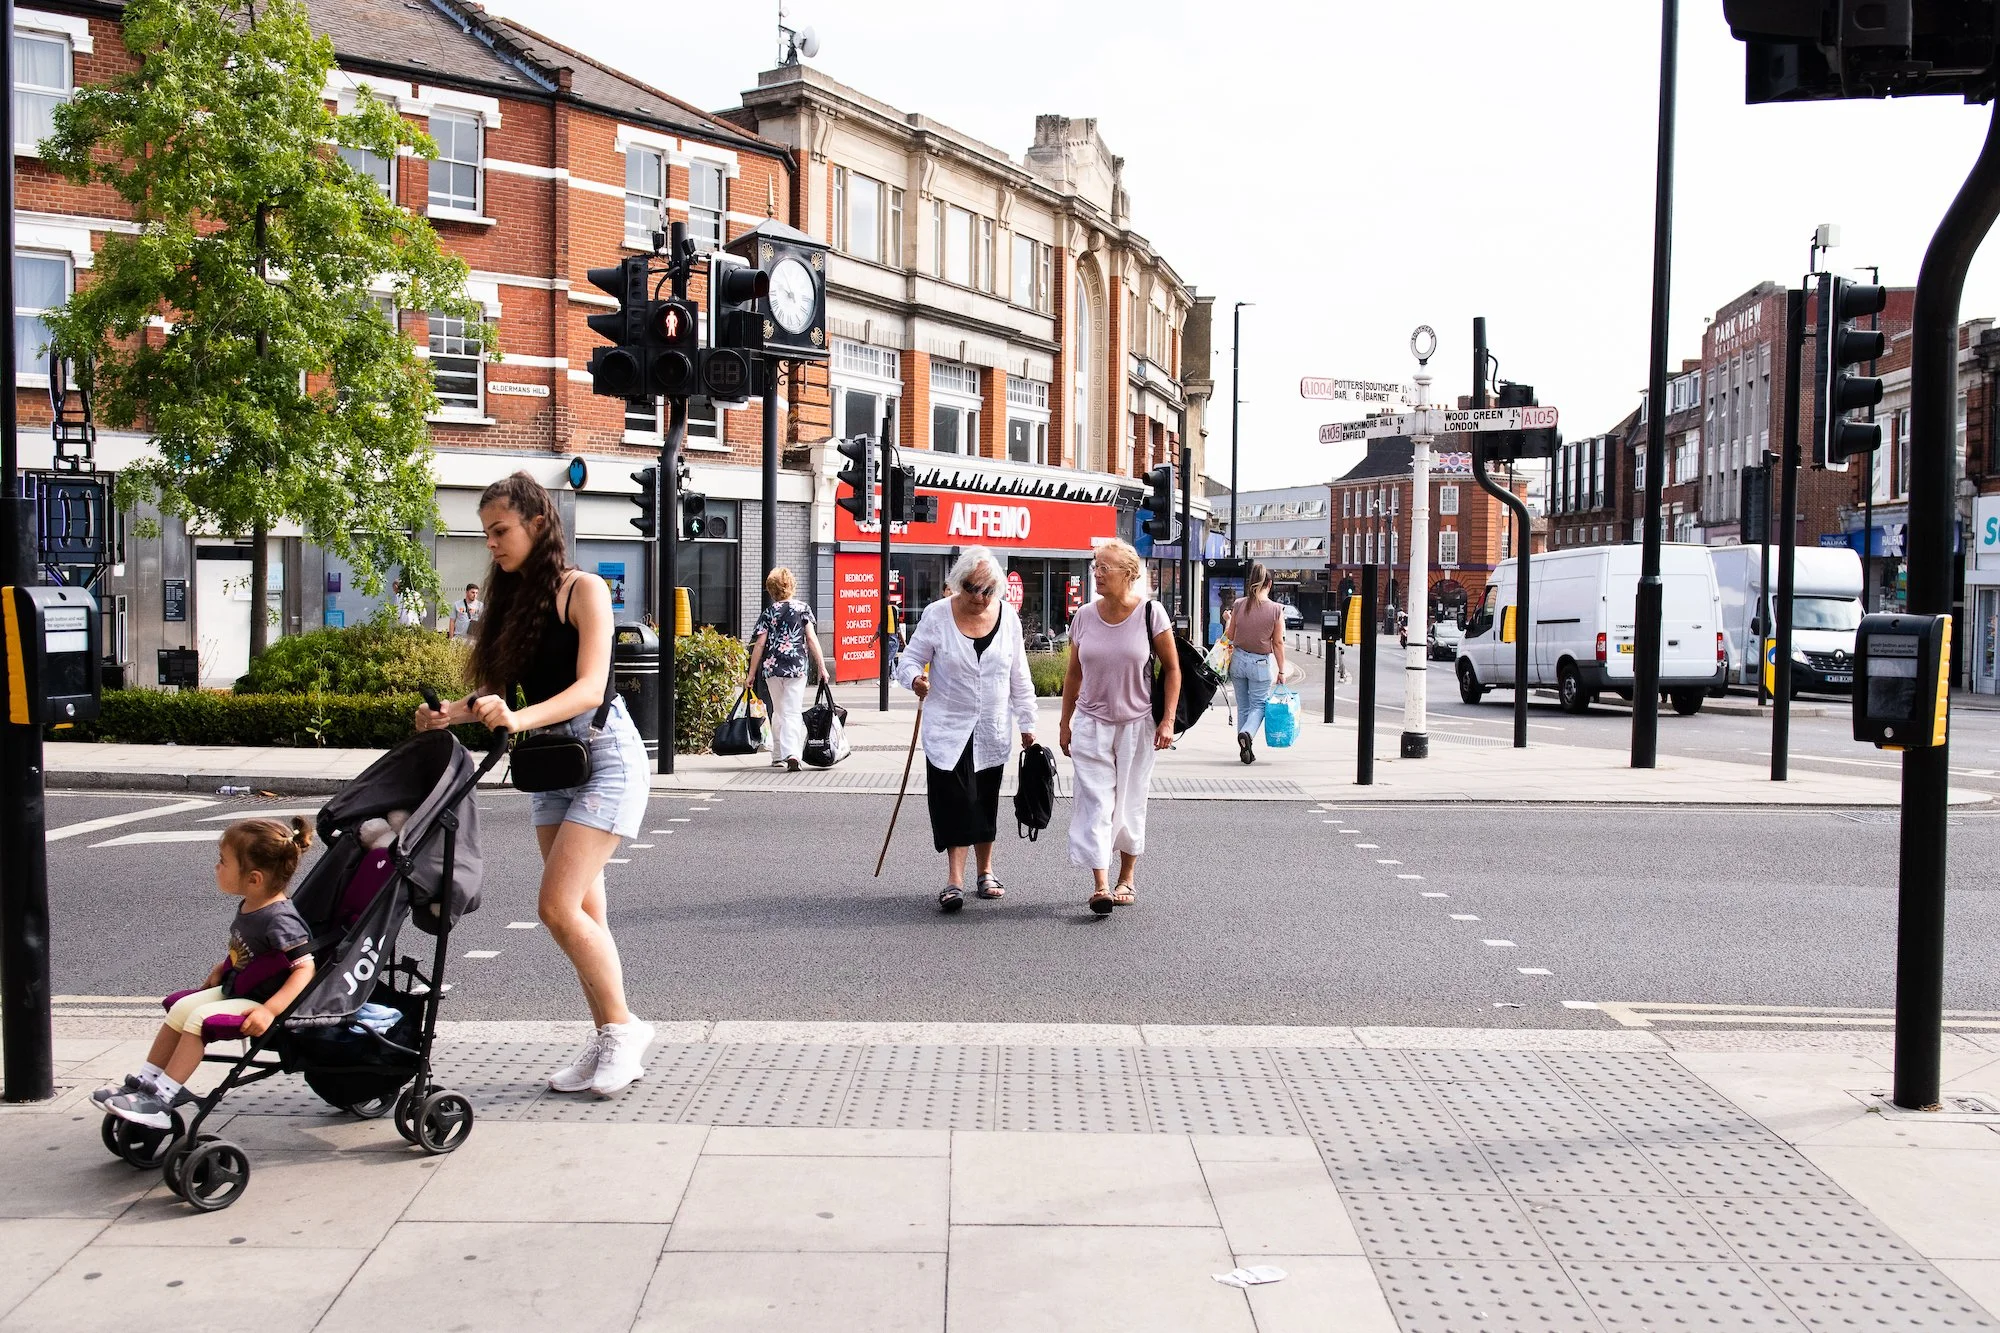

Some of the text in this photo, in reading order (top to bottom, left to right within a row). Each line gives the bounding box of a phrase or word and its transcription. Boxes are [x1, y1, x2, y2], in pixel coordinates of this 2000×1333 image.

[1715, 302, 1762, 345] PARK VIEW
[492, 385, 531, 394] ALDERMANS
[1304, 381, 1333, 396] A1004
[1335, 380, 1363, 390] POTTERS
[1366, 383, 1399, 393] SOUTHGATE
[1335, 390, 1346, 399] BAR
[1366, 392, 1390, 402] BARNET
[1445, 412, 1469, 420] WOOD
[1473, 410, 1503, 419] GREEN
[1524, 410, 1554, 425] A105
[1343, 420, 1377, 431] WINCHMORE
[1380, 418, 1392, 427] HILL
[1444, 420, 1515, 431] LONDON 7
[1321, 426, 1340, 440] A105
[1343, 426, 1401, 440] ENFIELD 3
[1984, 516, 2000, 546] S
[844, 573, 874, 583] BEDROOMS
[840, 589, 878, 598] DINING ROOMS
[848, 605, 871, 613] TV UNITS
[842, 636, 858, 645] HOME
[843, 650, 875, 660] ACCESSORIES
